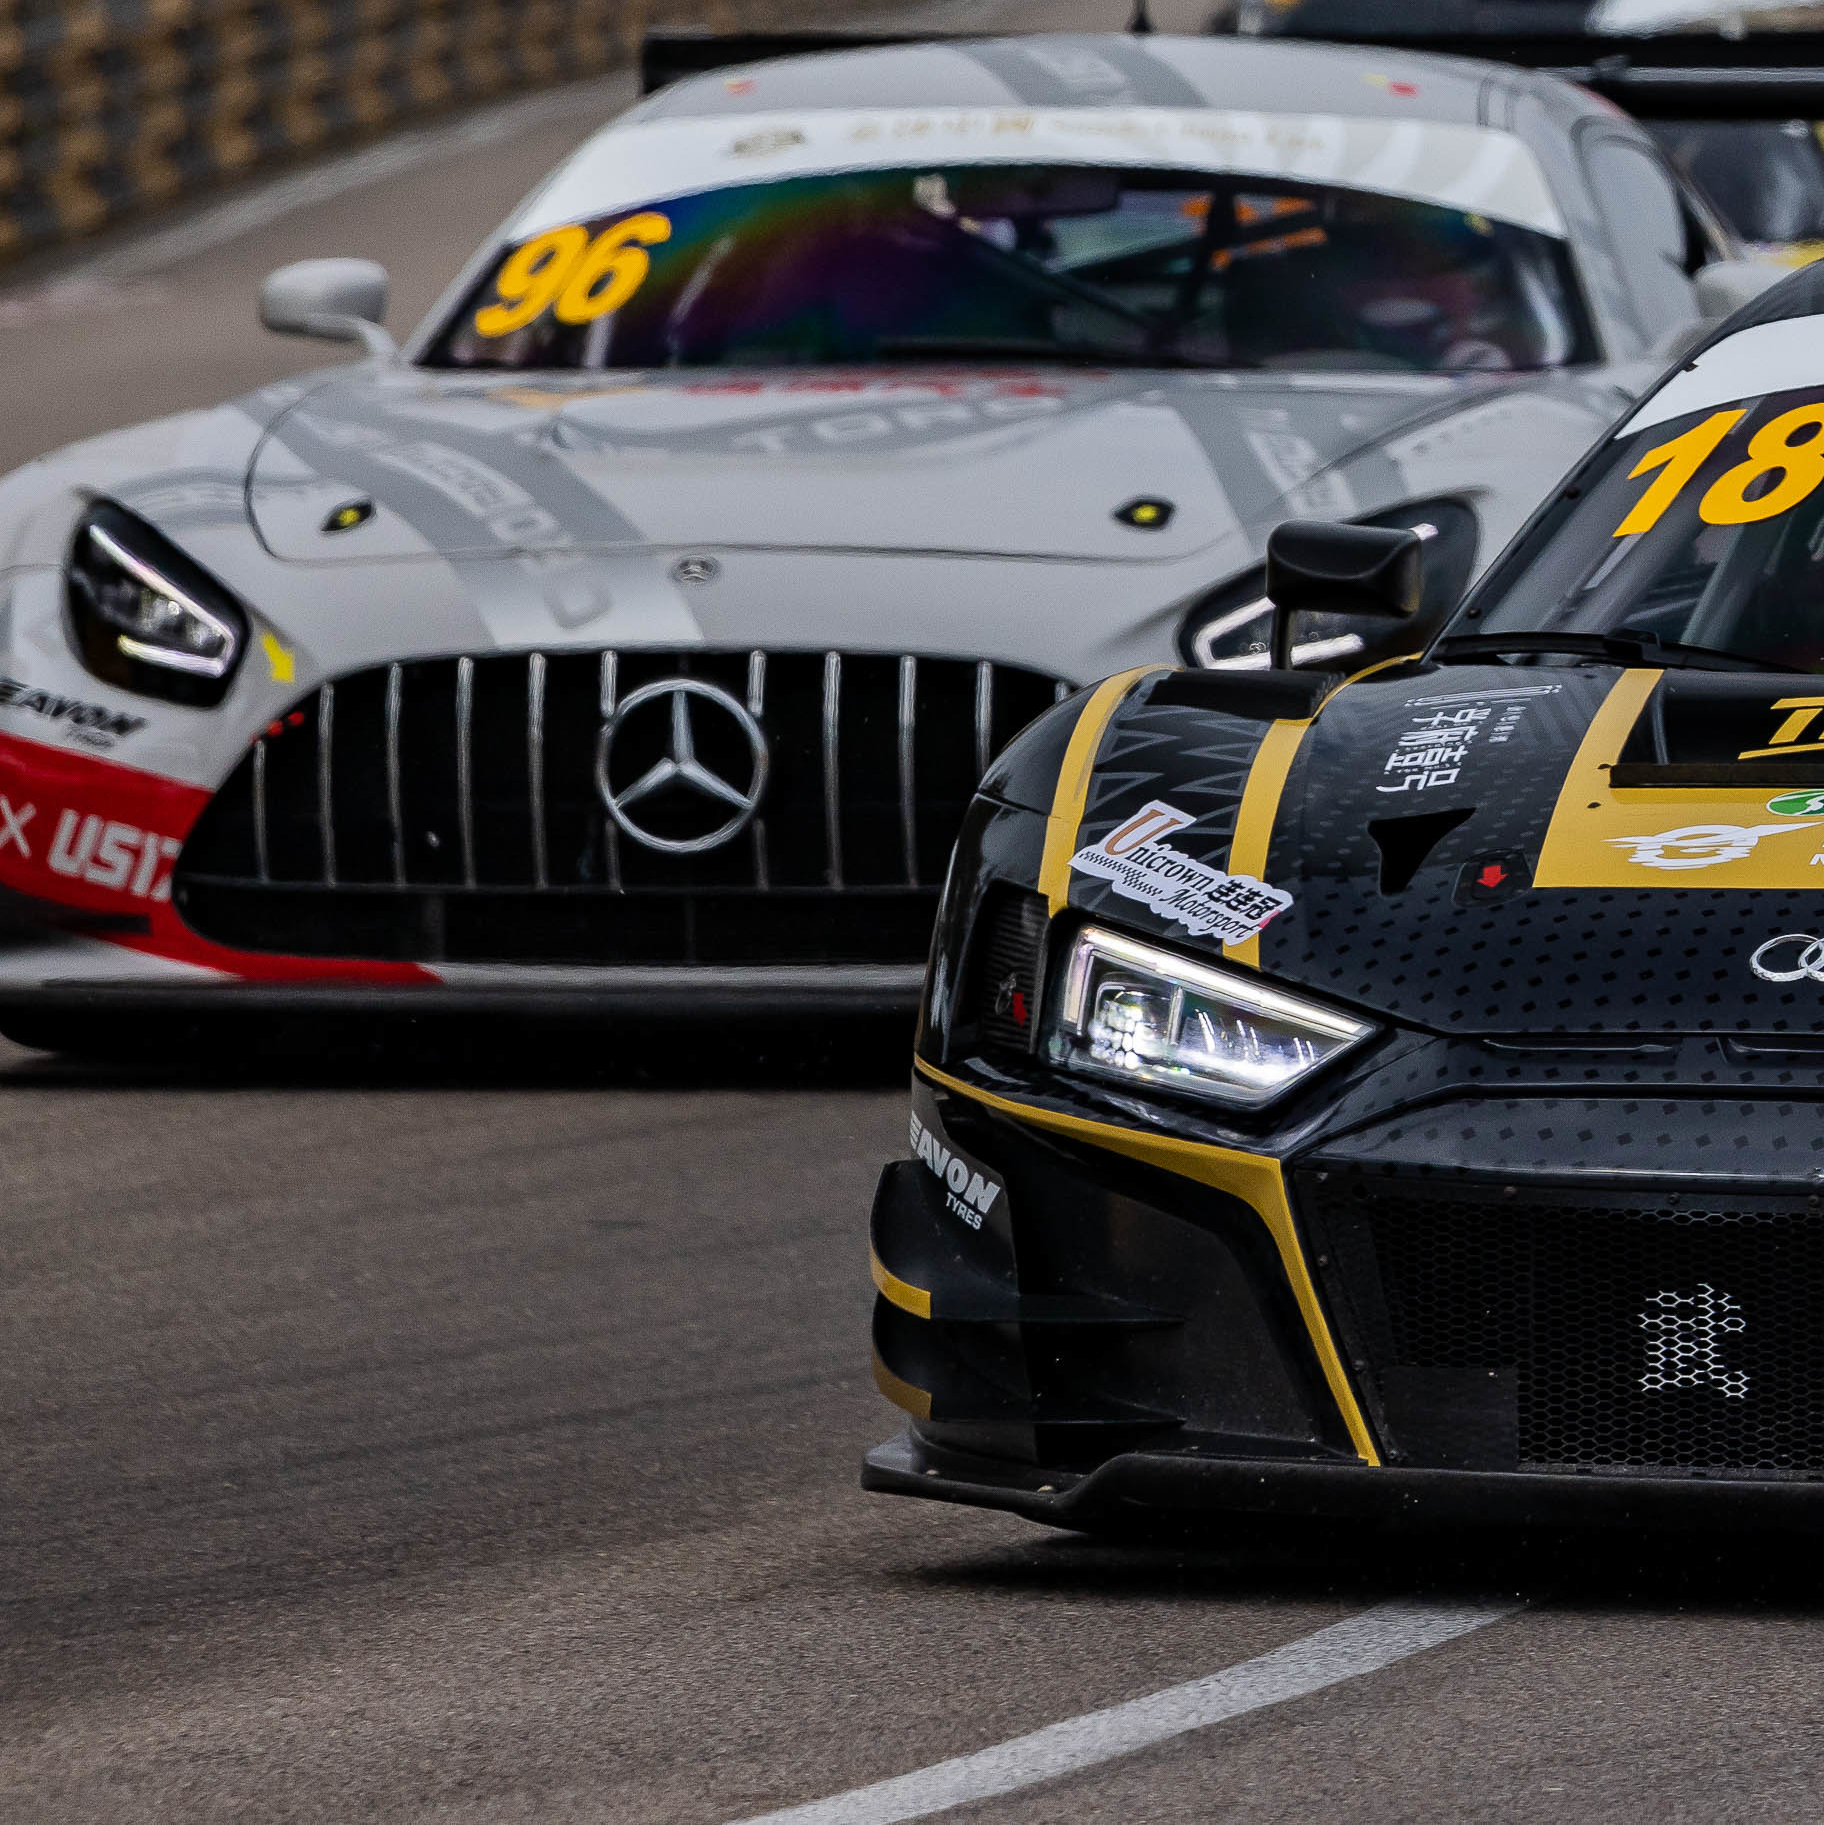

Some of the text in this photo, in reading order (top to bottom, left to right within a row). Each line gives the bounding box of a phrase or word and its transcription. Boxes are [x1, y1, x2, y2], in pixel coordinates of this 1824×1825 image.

[475, 211, 673, 338] 96
[1104, 808, 1216, 894] Unicrown
[1159, 887, 1257, 939] Motorsport
[917, 1127, 1001, 1215] AVON
[945, 1192, 983, 1231] TYRES
